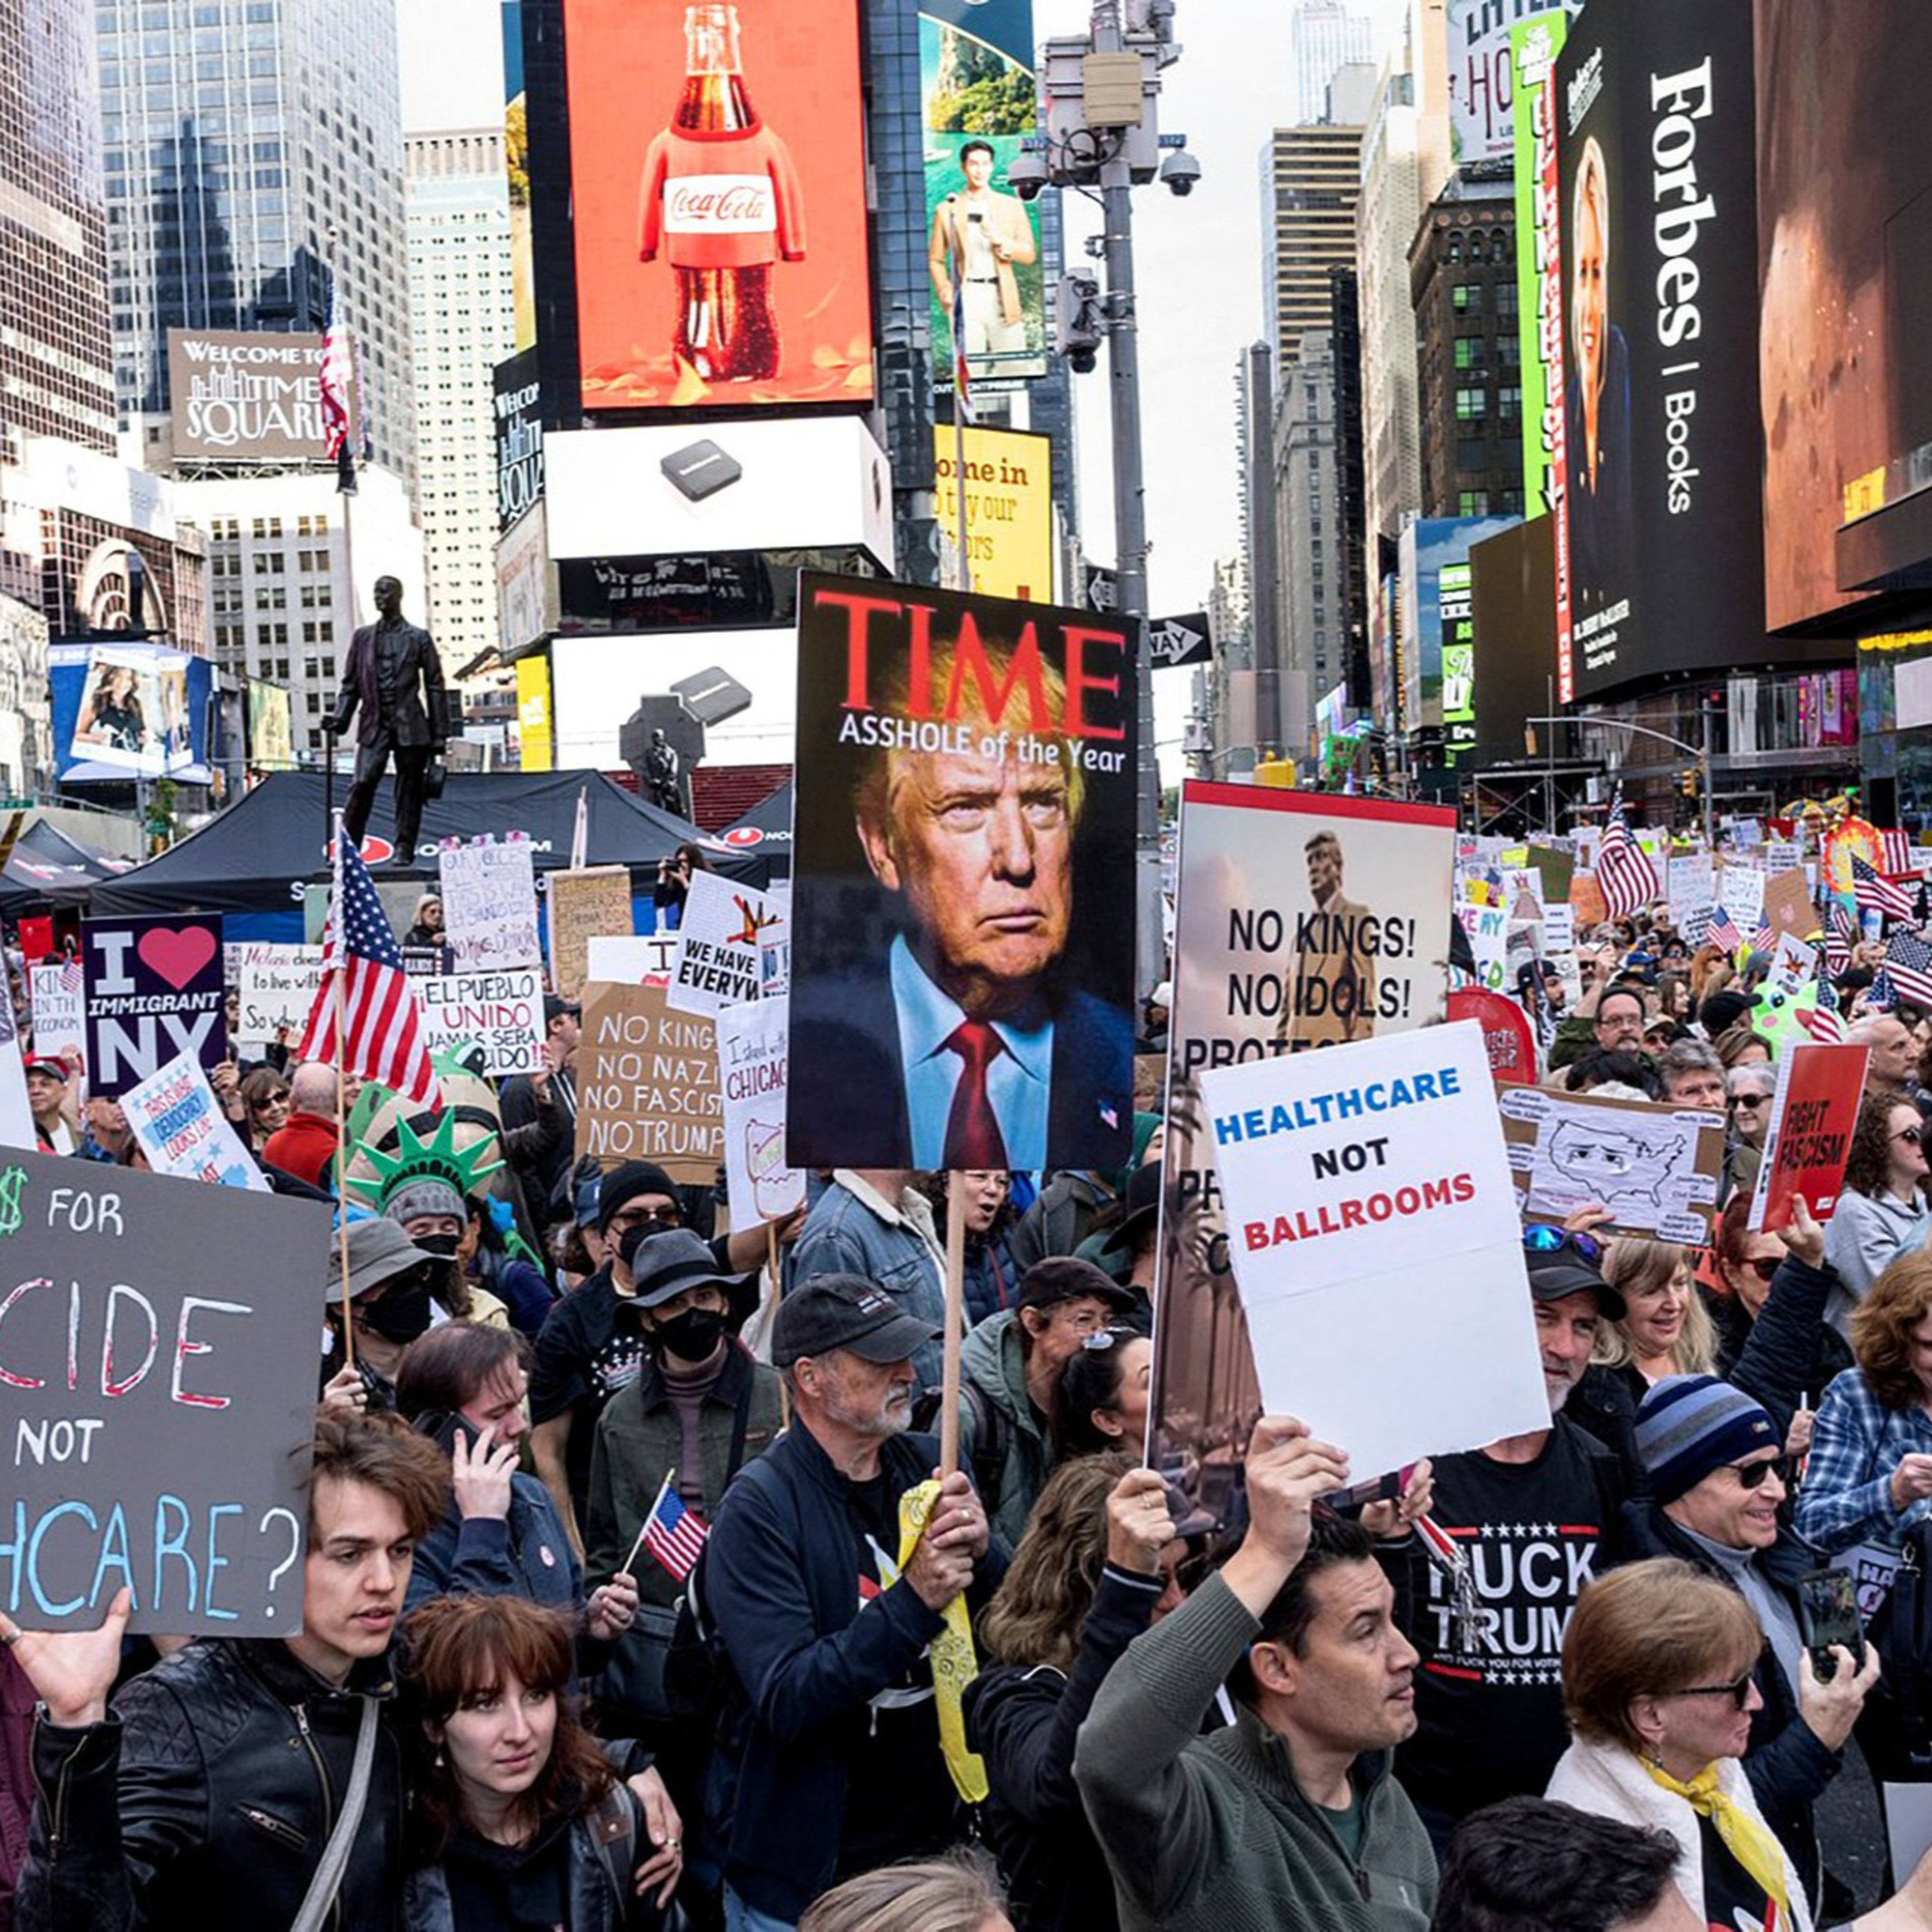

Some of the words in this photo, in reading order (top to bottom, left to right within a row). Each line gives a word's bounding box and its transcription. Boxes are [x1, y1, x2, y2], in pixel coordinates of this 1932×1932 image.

[671, 186, 767, 220] Coca-Cola
[1651, 56, 1717, 347] Forbes
[182, 341, 299, 364] WELCOME
[247, 375, 321, 401] TIME
[936, 458, 995, 483] ome
[999, 457, 1028, 486] in
[1665, 390, 1700, 514] Books
[815, 589, 1126, 740] TIME
[838, 713, 971, 755] ASSHOLE
[980, 734, 1008, 766] of
[1016, 734, 1059, 765] the
[1067, 739, 1126, 773] Year
[1228, 909, 1283, 952] NO
[1296, 912, 1415, 958] KINGS!
[93, 931, 135, 995] I
[686, 938, 712, 962] WE
[714, 947, 756, 974] HAVE
[457, 974, 535, 1003] PUEBLO
[678, 960, 760, 1001] EVERYW
[1228, 974, 1282, 1016] NO
[1294, 976, 1410, 1018] IDOLS!
[88, 992, 221, 1016] IMMIGRANT
[245, 1005, 267, 1029] So
[442, 1003, 533, 1030] UNIDO
[97, 1012, 218, 1084] NY
[598, 1012, 650, 1045] NO
[658, 1017, 717, 1053] KING
[726, 1035, 741, 1065] I
[596, 1053, 642, 1081] NO
[652, 1054, 718, 1086] NAZI
[584, 1084, 623, 1110] NO
[633, 1085, 724, 1116] FASCIST
[1215, 1067, 1461, 1145] HEALTHCARE
[587, 1118, 634, 1156] NO
[636, 1119, 726, 1156] TRUMP
[1778, 1133, 1846, 1174] FASCISM
[1311, 1137, 1389, 1180] NOT
[48, 1188, 124, 1236] FOR
[1244, 1173, 1475, 1251] BALLROOMS
[0, 1278, 253, 1408] CIDE
[15, 1418, 104, 1466] NOT
[0, 1494, 301, 1619] HCARE?
[1427, 1605, 1576, 1655] TRUM
[1457, 1654, 1486, 1668] FUCK
[1488, 1658, 1510, 1669] YOU
[1511, 1658, 1533, 1669] FOR
